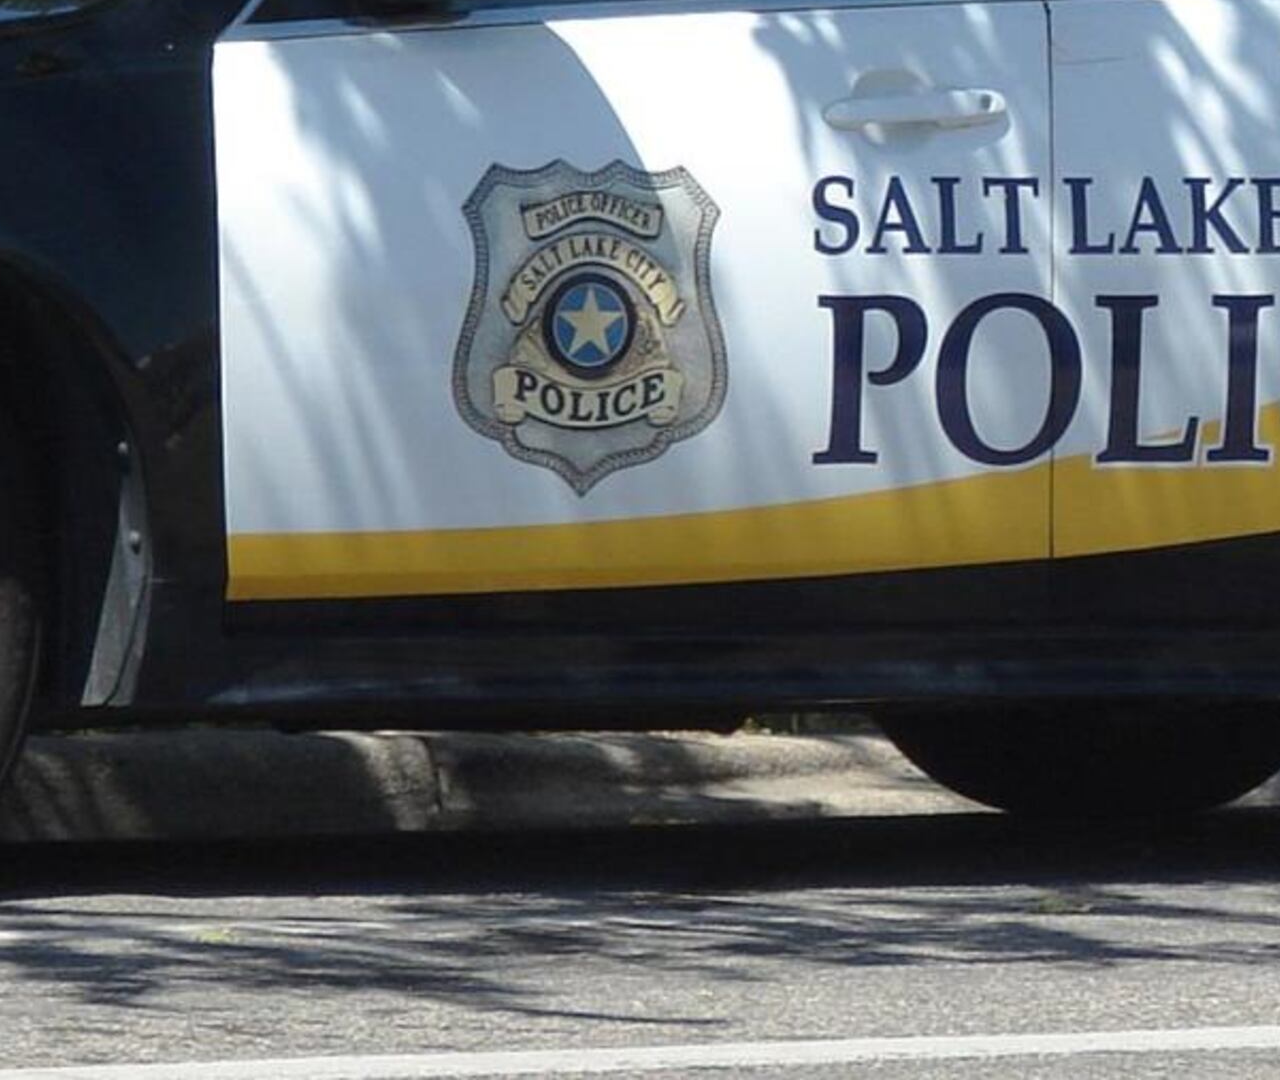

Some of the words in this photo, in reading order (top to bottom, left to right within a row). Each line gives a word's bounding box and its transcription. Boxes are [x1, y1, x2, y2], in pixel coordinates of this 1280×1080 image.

[535, 194, 584, 230] POLICE
[590, 193, 651, 230] OFFICER
[811, 176, 1040, 256] SALT
[521, 246, 563, 291] SALT
[568, 237, 621, 260] LAKE
[626, 249, 666, 290] CITY
[513, 369, 667, 421] POLICE
